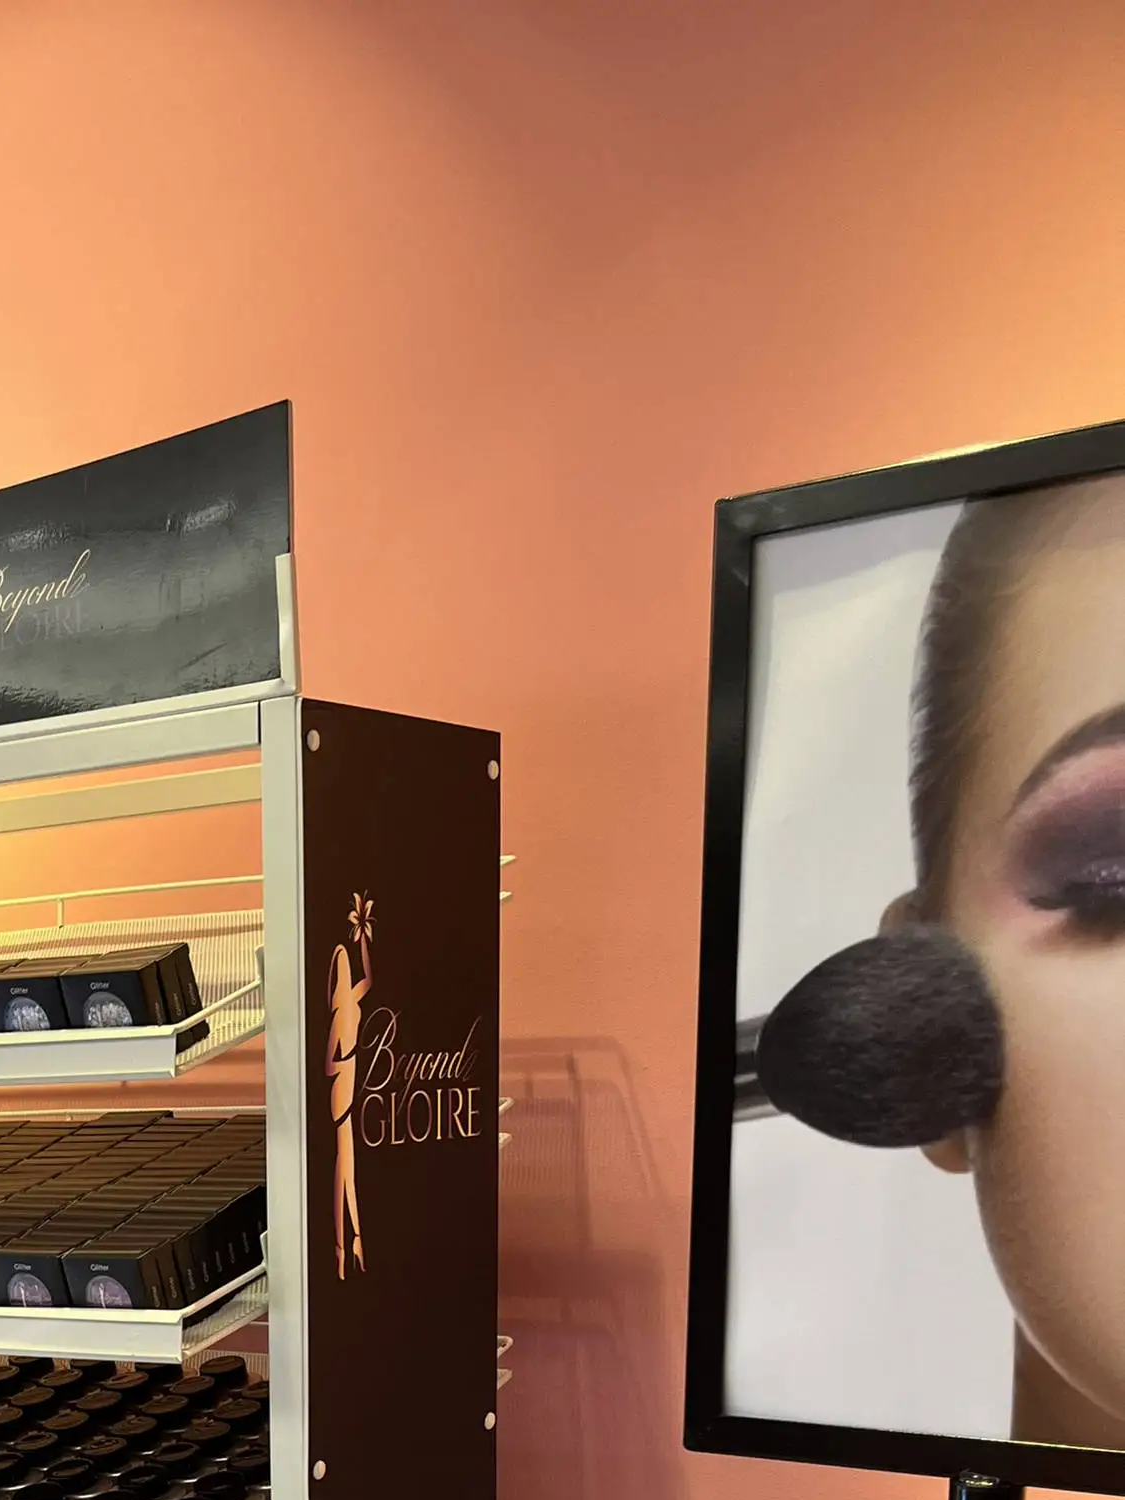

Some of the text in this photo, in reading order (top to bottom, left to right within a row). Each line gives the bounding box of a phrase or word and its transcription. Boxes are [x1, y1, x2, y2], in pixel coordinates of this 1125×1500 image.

[90, 981, 110, 990] Glitter
[10, 987, 29, 995] Glitter
[359, 1006, 482, 1111] Beyond
[359, 1087, 482, 1148] GLOIRE
[14, 1263, 32, 1271] Glitter
[90, 1263, 110, 1272] Glitter
